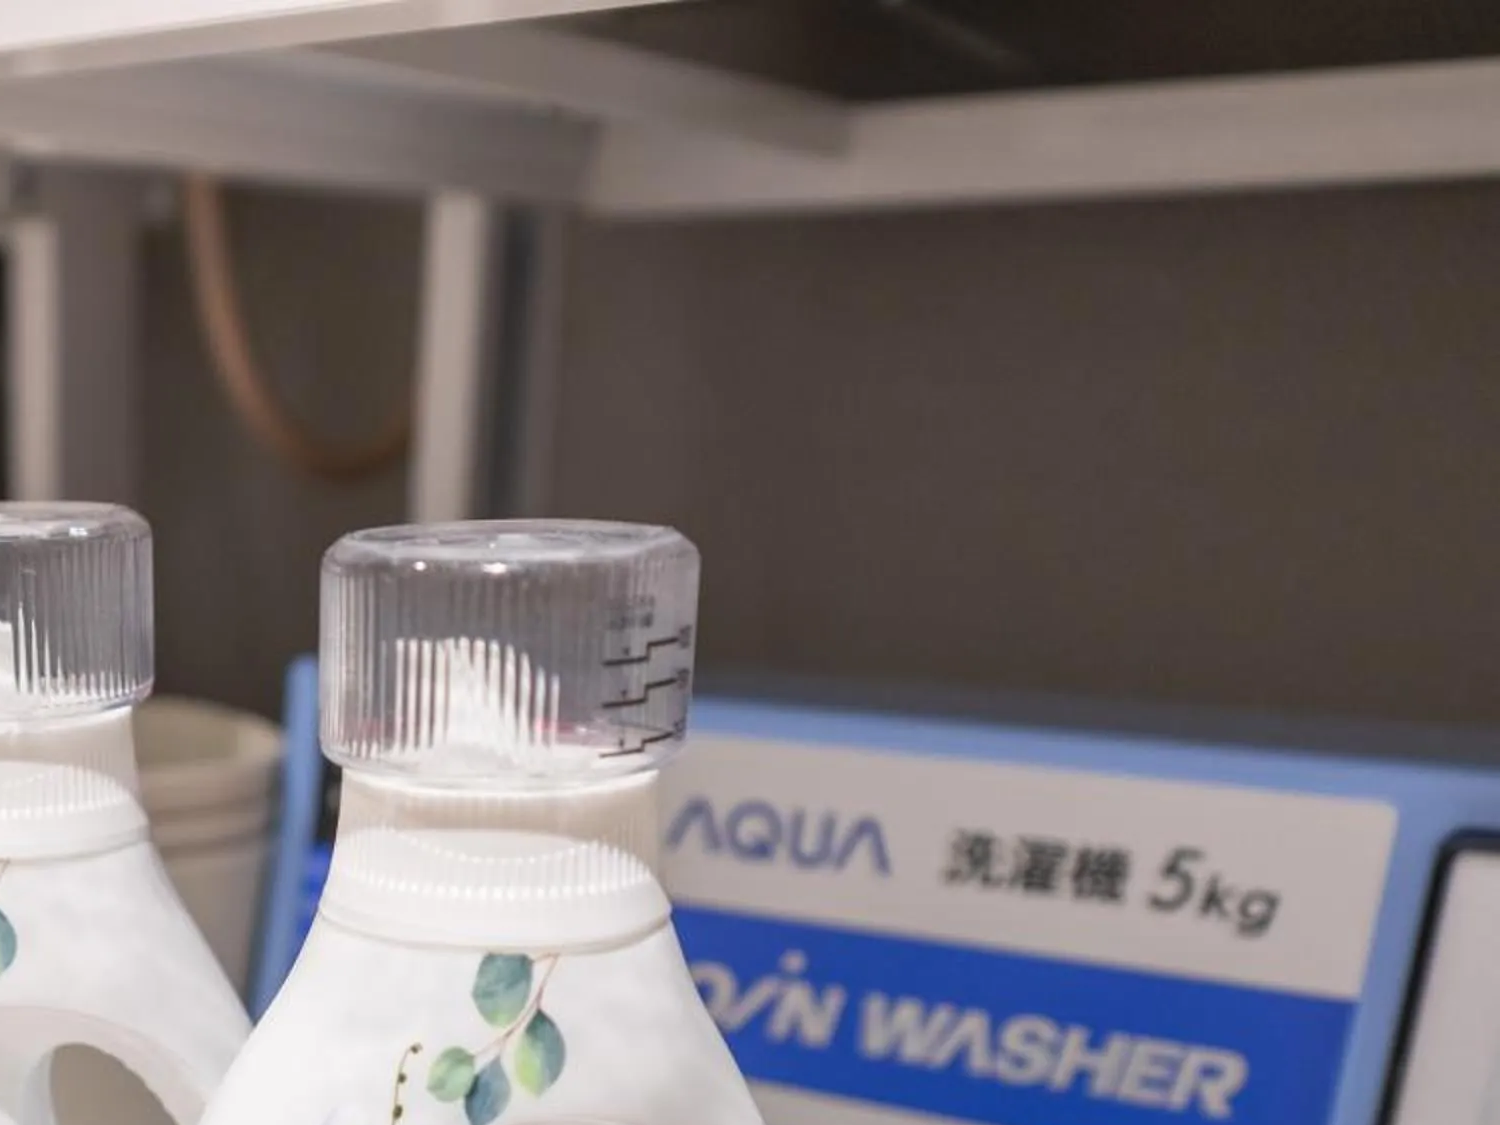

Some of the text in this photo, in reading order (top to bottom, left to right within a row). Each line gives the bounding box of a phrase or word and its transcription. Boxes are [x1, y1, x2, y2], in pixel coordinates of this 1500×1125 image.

[664, 796, 891, 876] AQUA
[942, 828, 1280, 938] 洗濯機 5kg
[858, 992, 1249, 1119] WASHER
